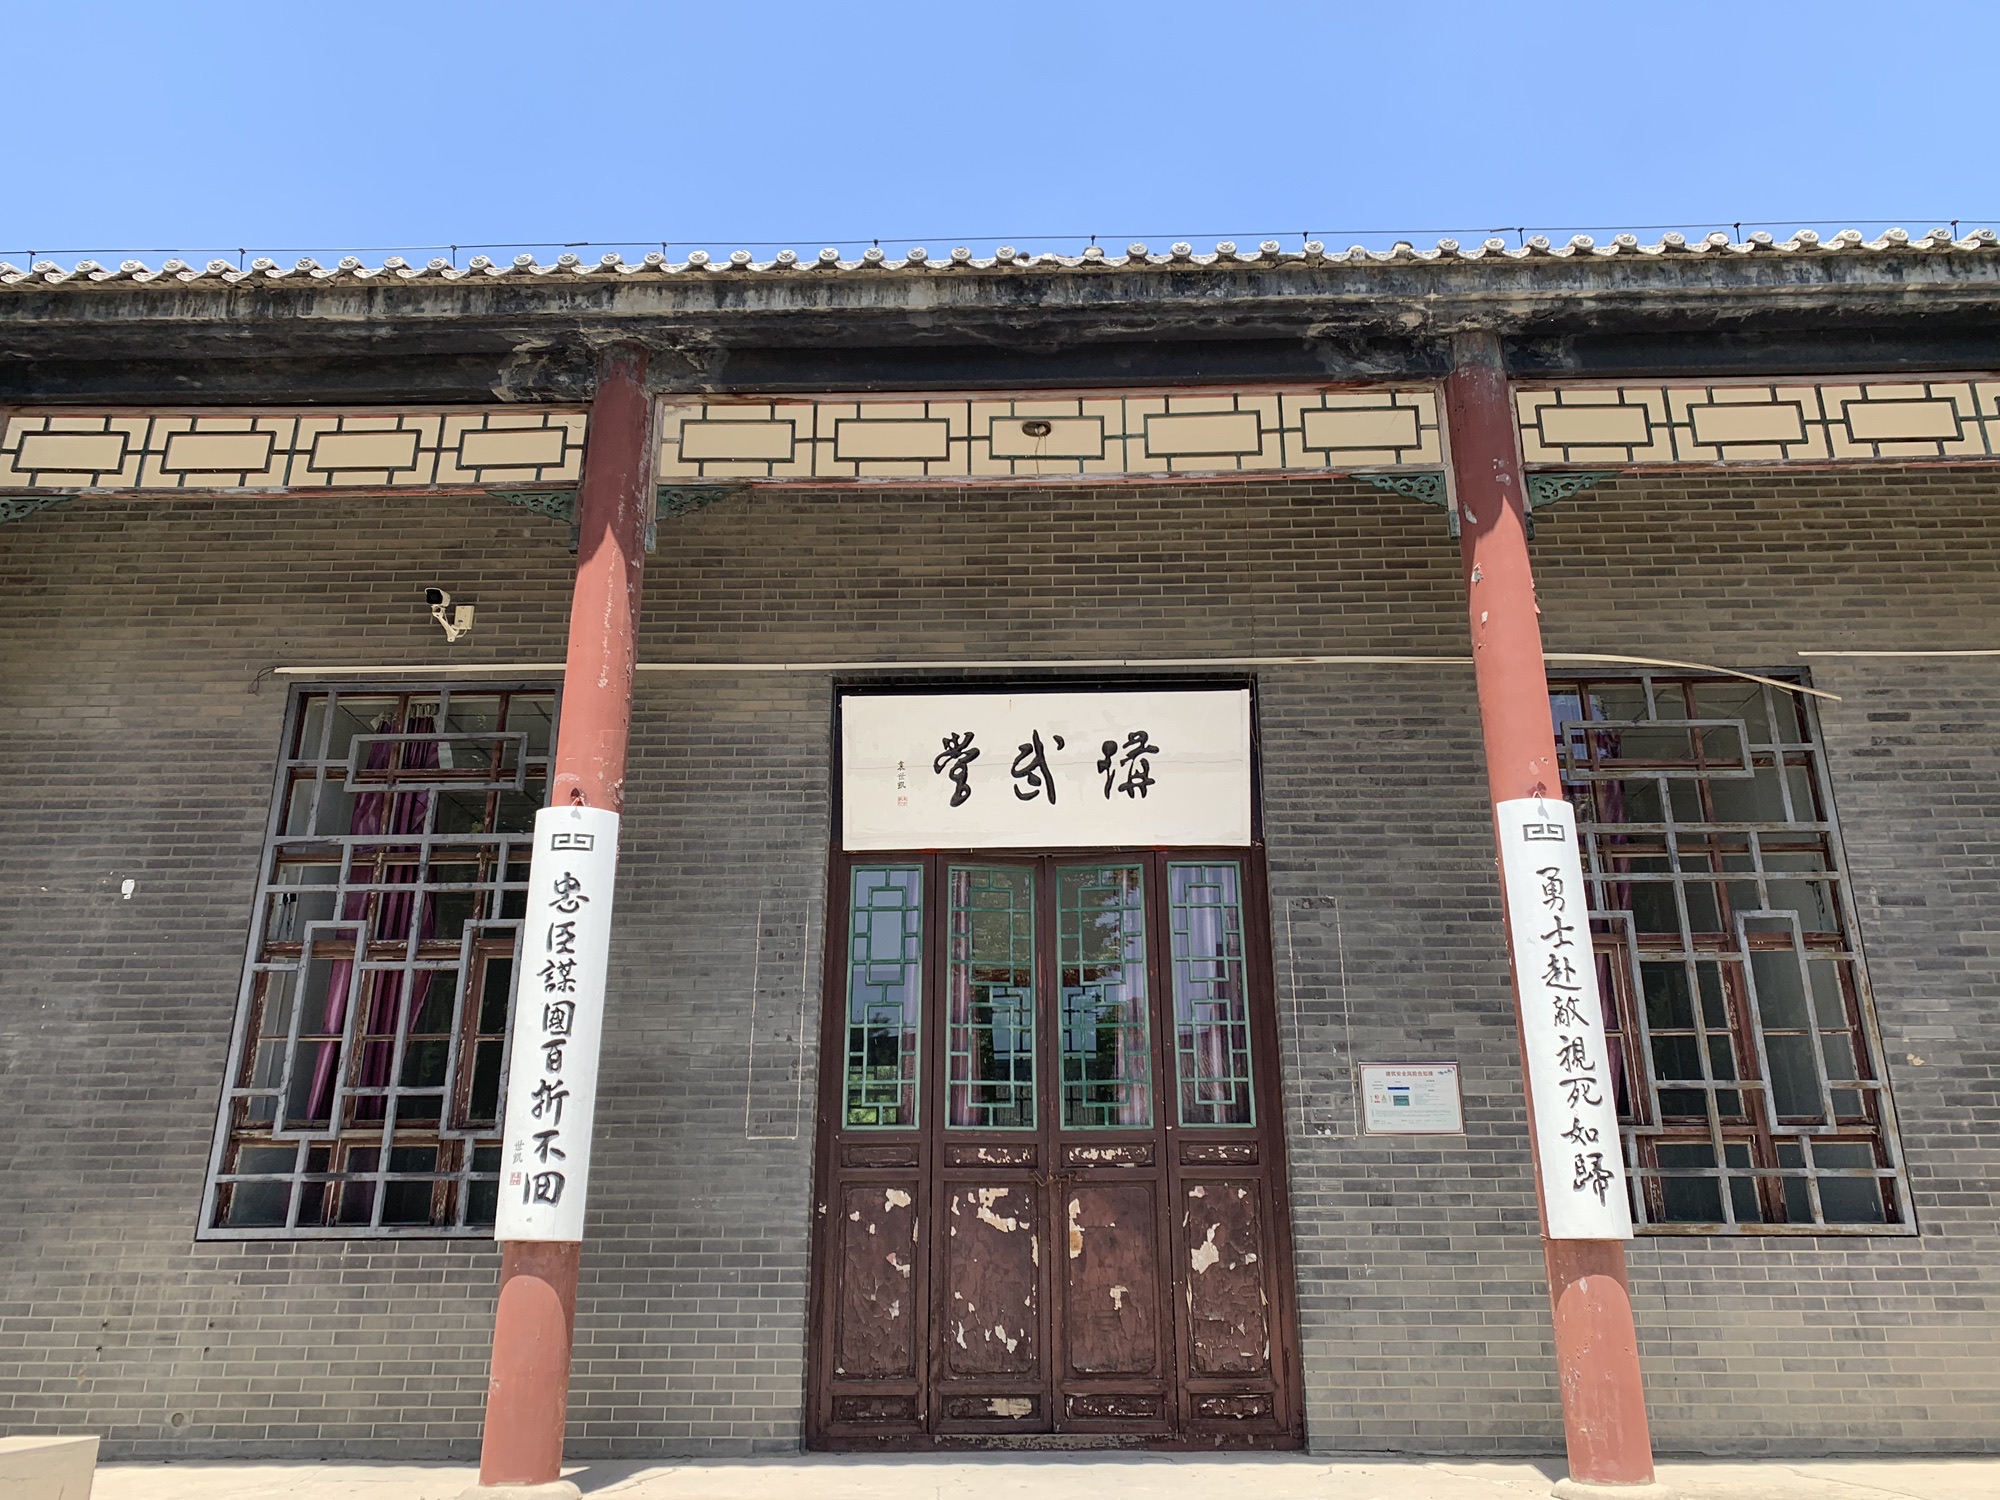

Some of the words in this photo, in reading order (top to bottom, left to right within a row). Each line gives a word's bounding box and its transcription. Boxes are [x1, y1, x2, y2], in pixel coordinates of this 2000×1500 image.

[1535, 866, 1614, 1207] 勇士赴敵視死如歸
